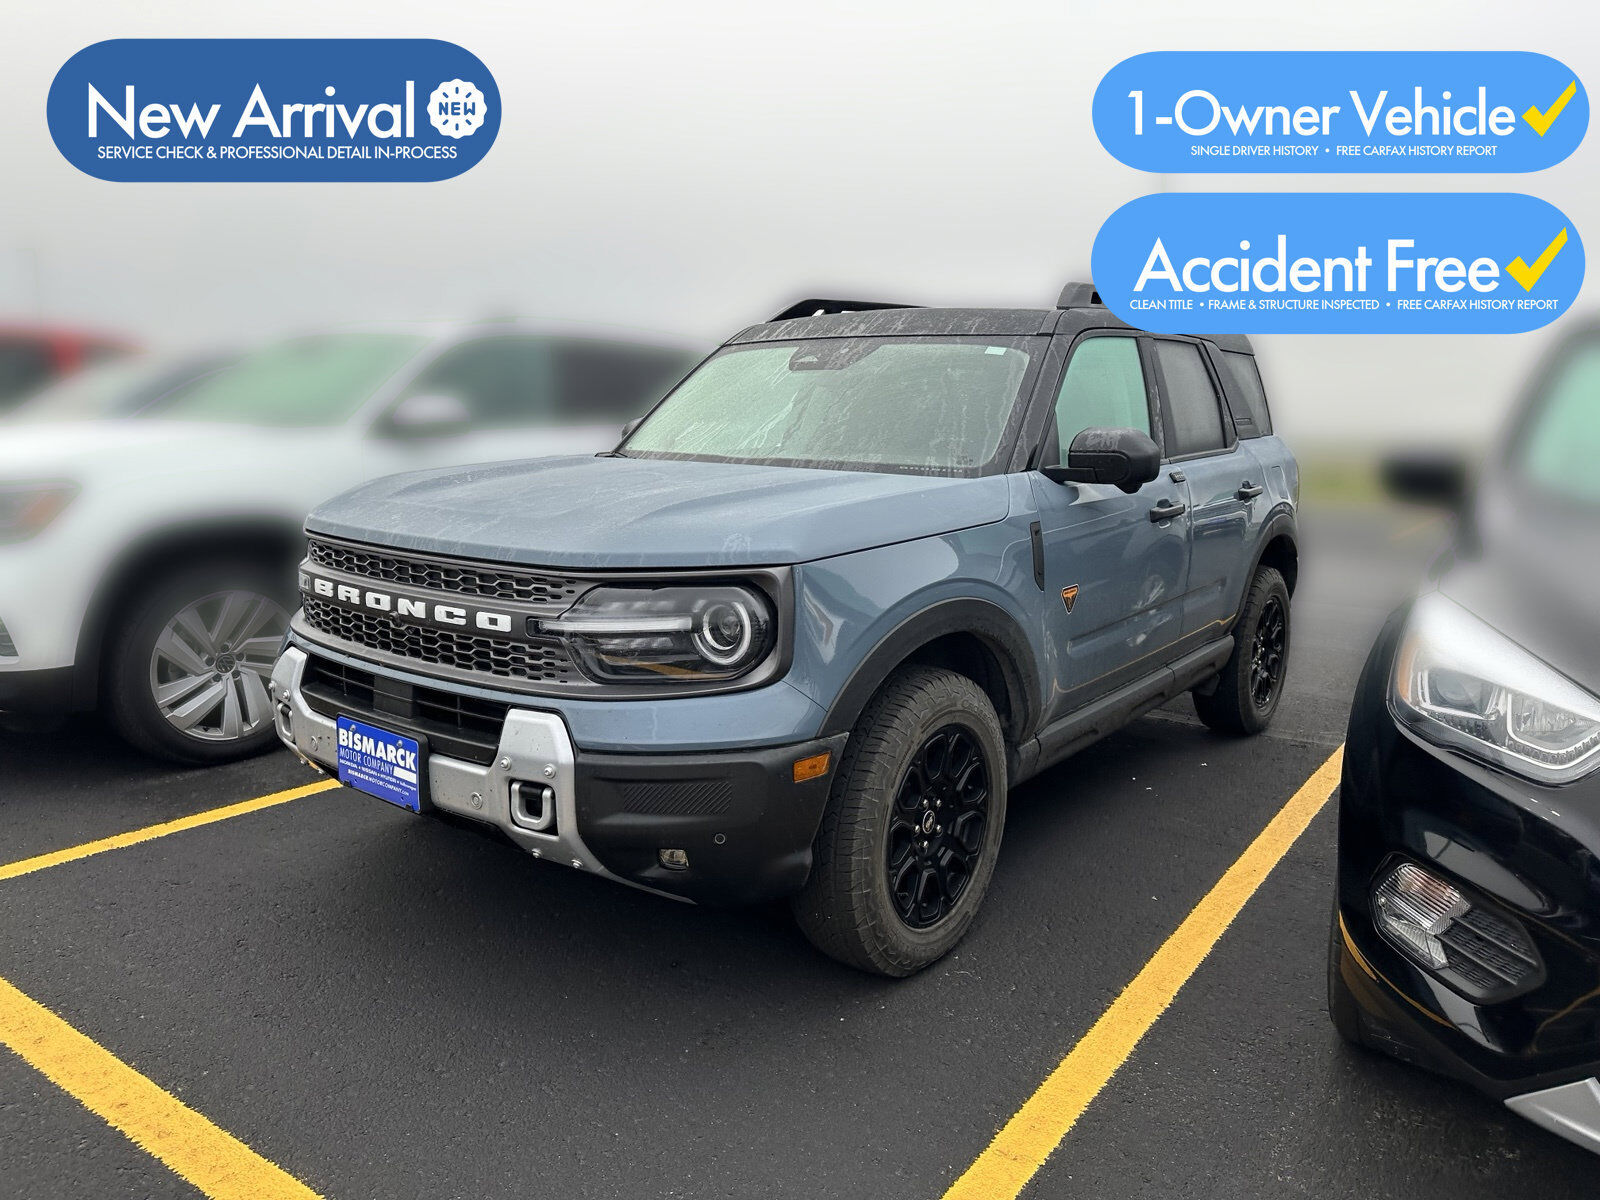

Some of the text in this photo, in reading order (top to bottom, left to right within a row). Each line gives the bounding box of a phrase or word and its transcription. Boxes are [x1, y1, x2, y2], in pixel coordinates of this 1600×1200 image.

[314, 578, 512, 632] BRONCO
[338, 727, 417, 772] BISMARCK
[339, 747, 394, 775] MOTOR COMPANY
